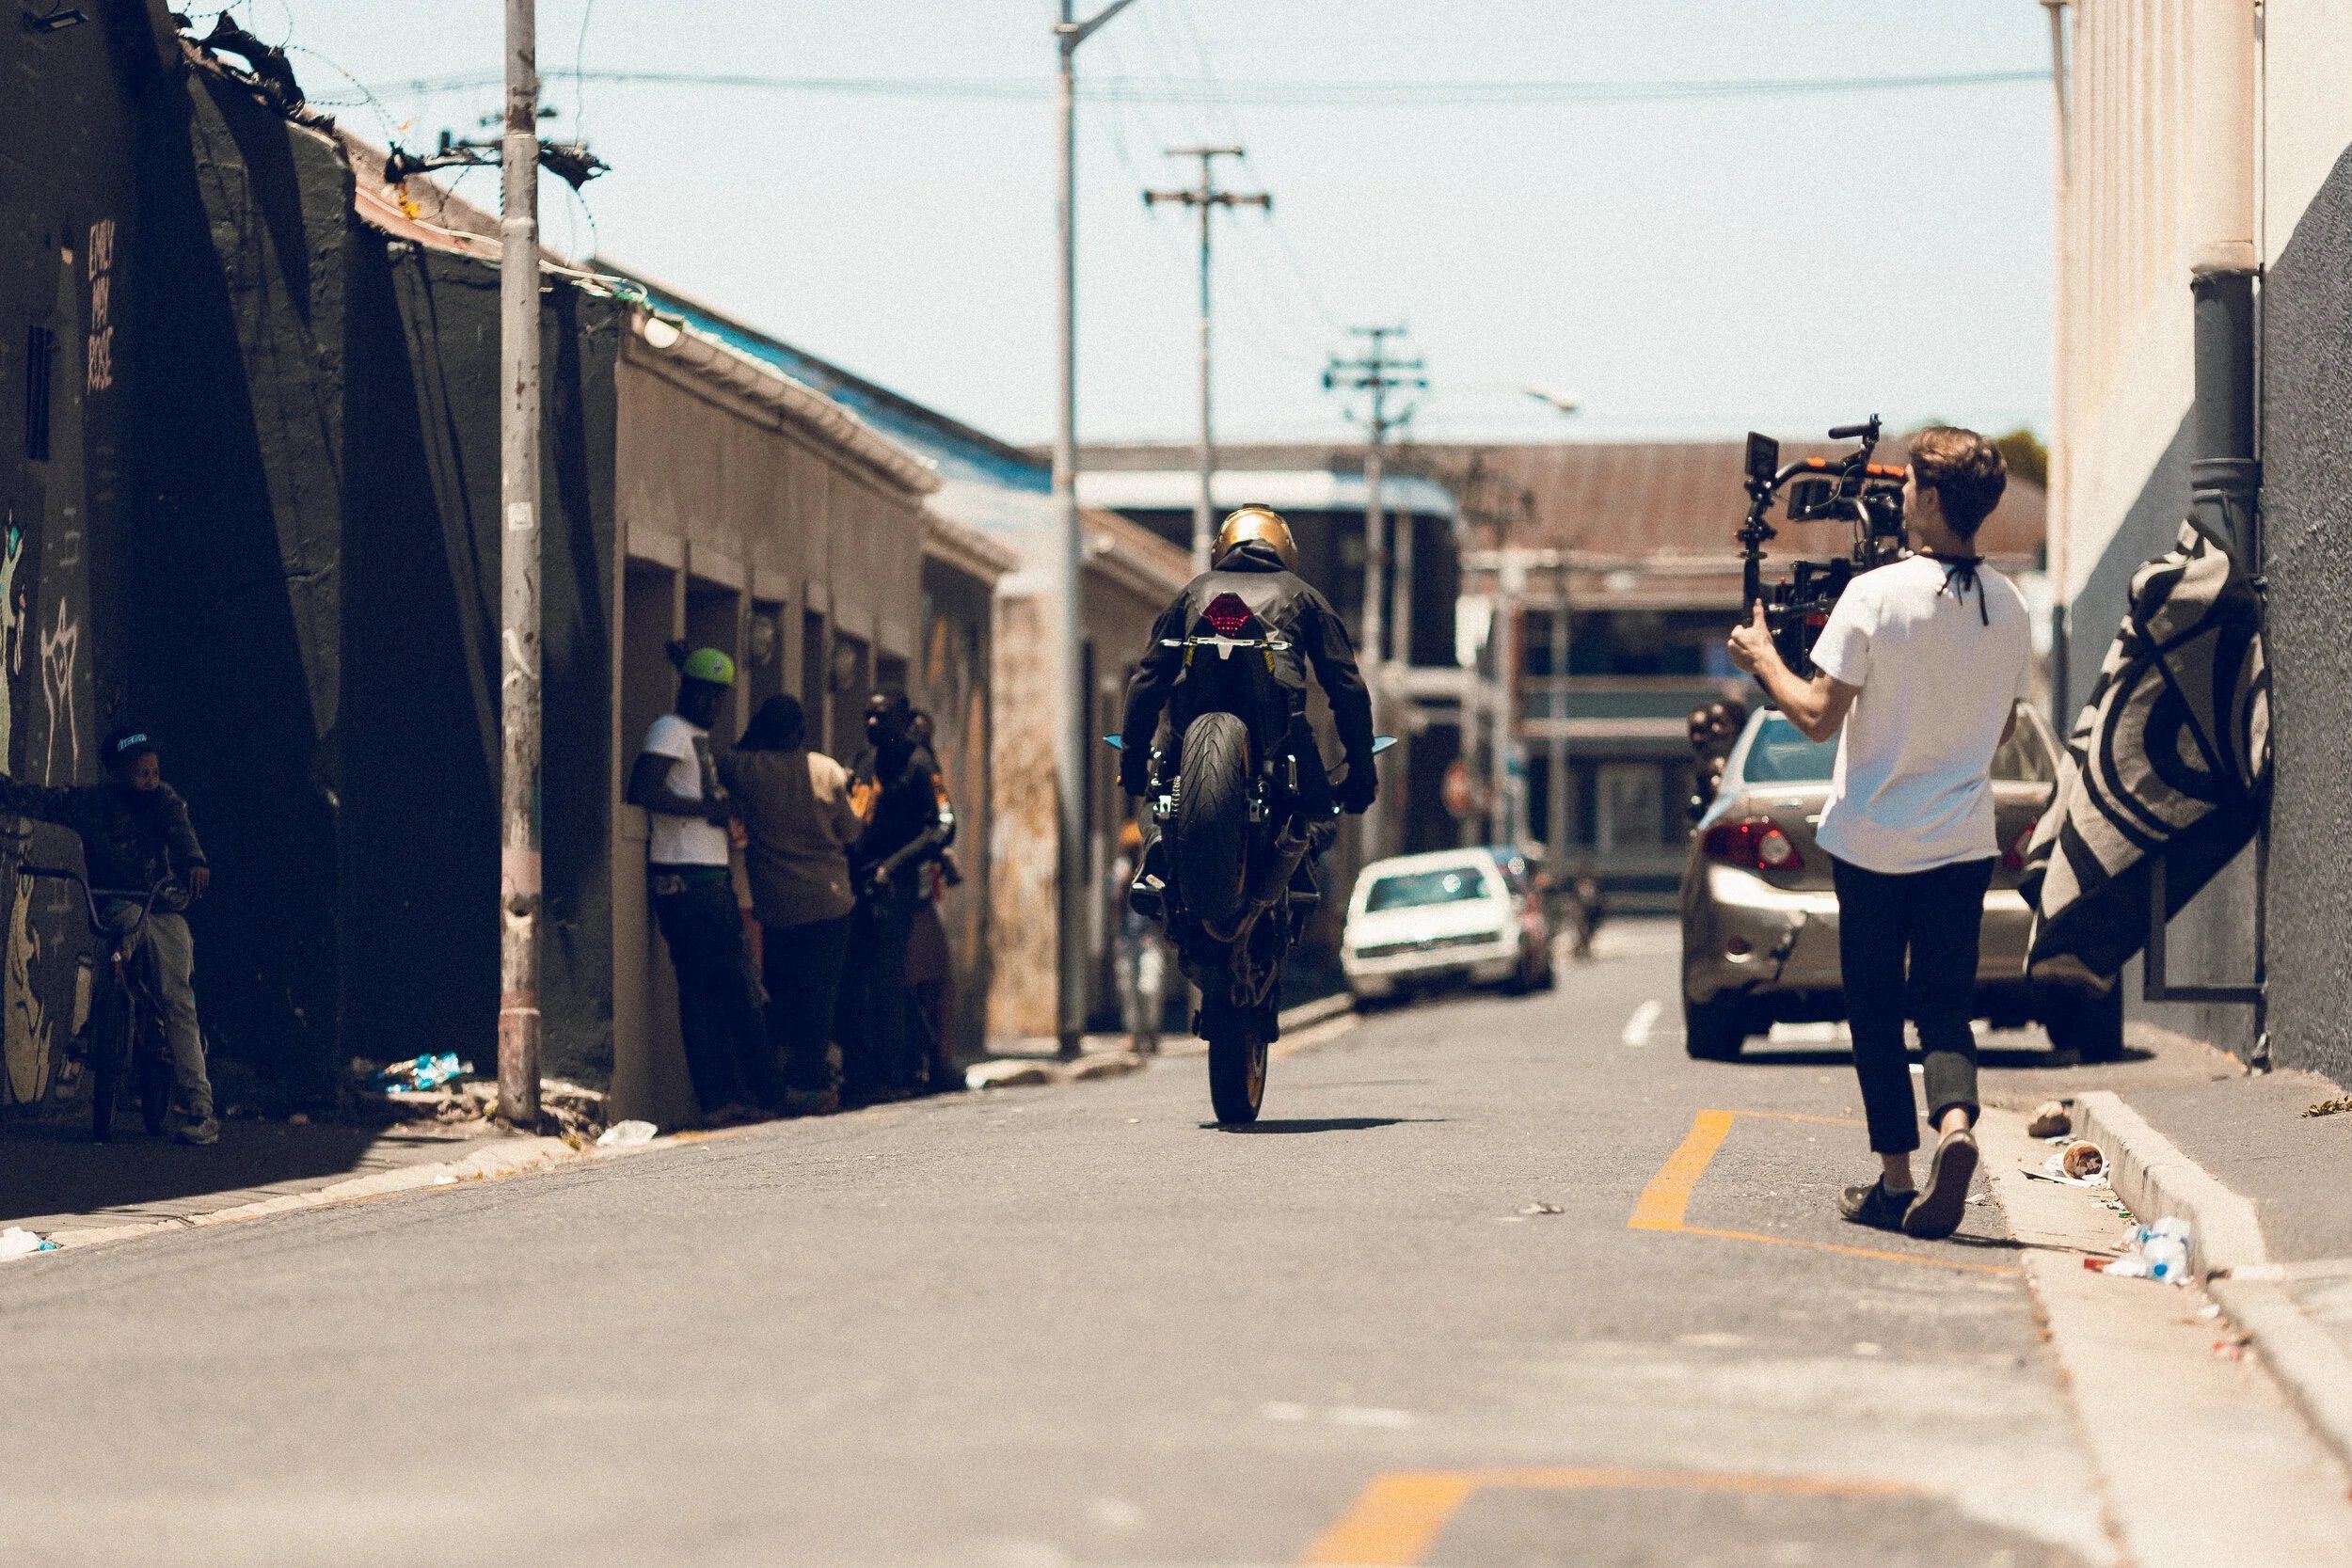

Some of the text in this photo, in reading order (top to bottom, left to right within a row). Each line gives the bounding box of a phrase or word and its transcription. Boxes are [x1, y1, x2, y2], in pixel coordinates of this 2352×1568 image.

[88, 219, 115, 281] EMILY
[92, 275, 109, 330] MAY
[87, 326, 113, 395] ROSE
